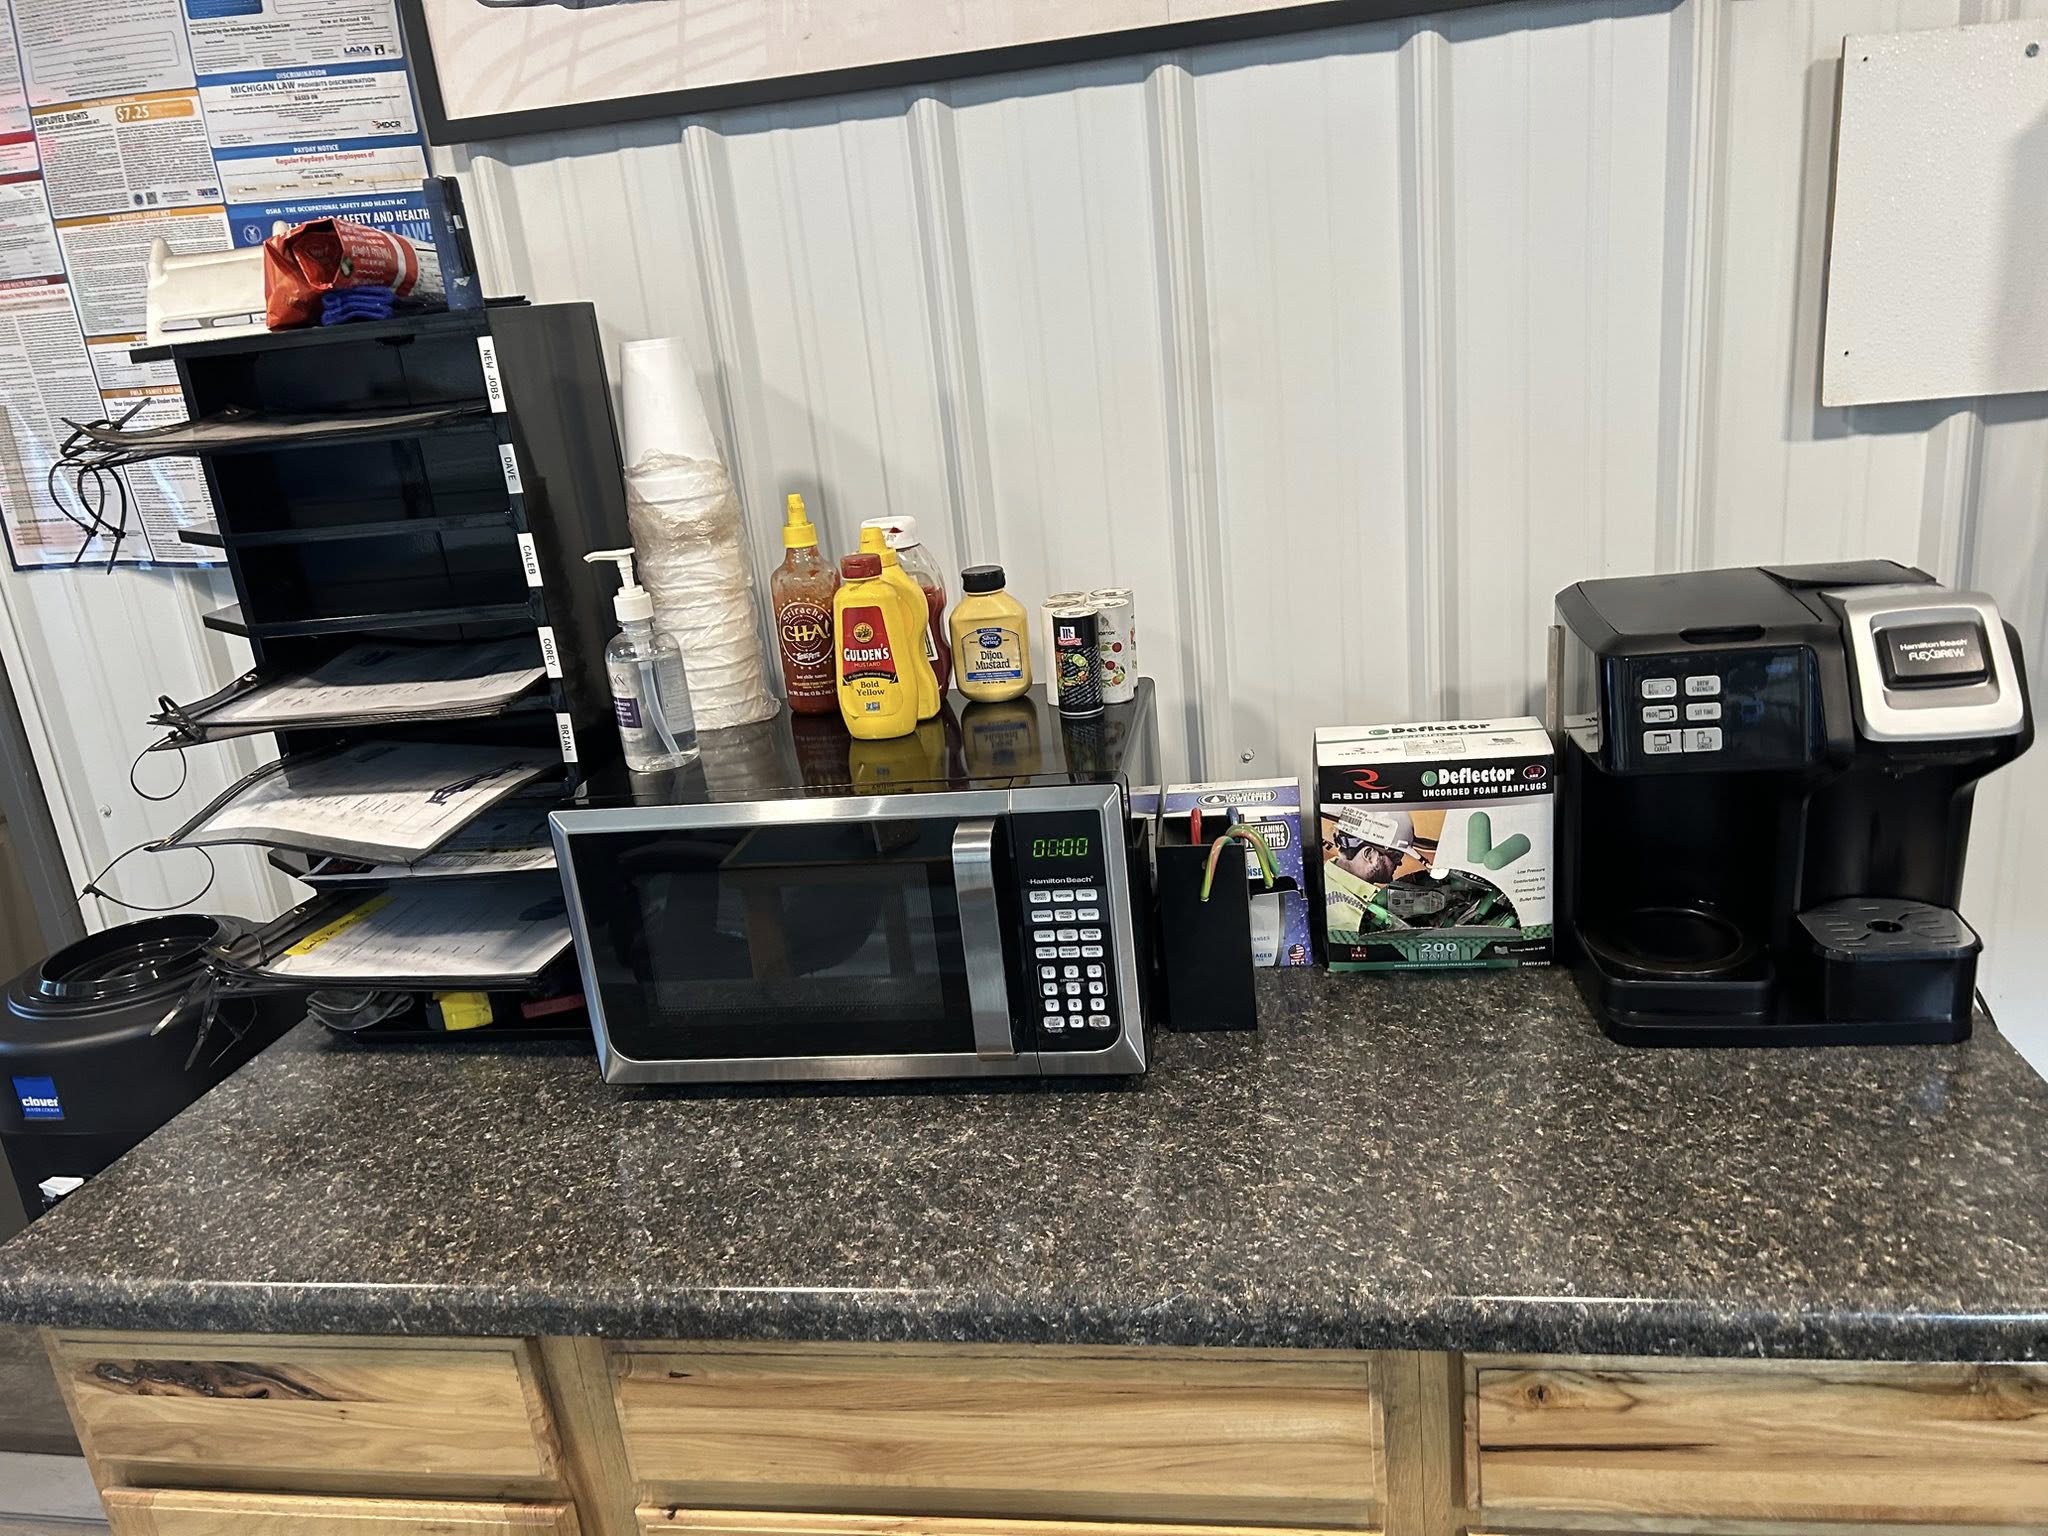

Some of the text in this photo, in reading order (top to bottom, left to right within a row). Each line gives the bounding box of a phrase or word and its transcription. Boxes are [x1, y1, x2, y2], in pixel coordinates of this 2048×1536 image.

[230, 83, 275, 94] MICHIGAN
[276, 81, 296, 90] LAW
[35, 114, 66, 126] EMPLOYEE
[117, 105, 150, 121] $7.25
[275, 157, 299, 166] Regular
[300, 155, 325, 164] Paydays
[335, 152, 368, 161] Employees
[373, 210, 394, 223] AND
[395, 208, 431, 222] HEALTH
[483, 349, 500, 400] NEW JOBS
[504, 456, 517, 481] DAVE
[523, 544, 537, 575] CALEB
[782, 607, 824, 623] Sriracha
[782, 618, 830, 642] CHA!
[543, 637, 556, 667] COREY
[1900, 638, 1968, 651] Hamilton Beach
[844, 643, 889, 662] GULDEN'S
[980, 650, 1003, 661] Dijon
[975, 658, 1011, 670] Mustard
[860, 680, 880, 688] Bold
[856, 689, 885, 697] Yellow
[1391, 723, 1491, 734] Deflector
[560, 723, 572, 752] BRIAN
[1438, 766, 1515, 785] Deflector
[1422, 782, 1547, 797] UNCORDED FOAM EARPLUGS
[1033, 837, 1088, 858] 00:00
[1066, 876, 1092, 884] Beach
[1421, 942, 1457, 952] 200
[22, 1096, 59, 1107] clover
